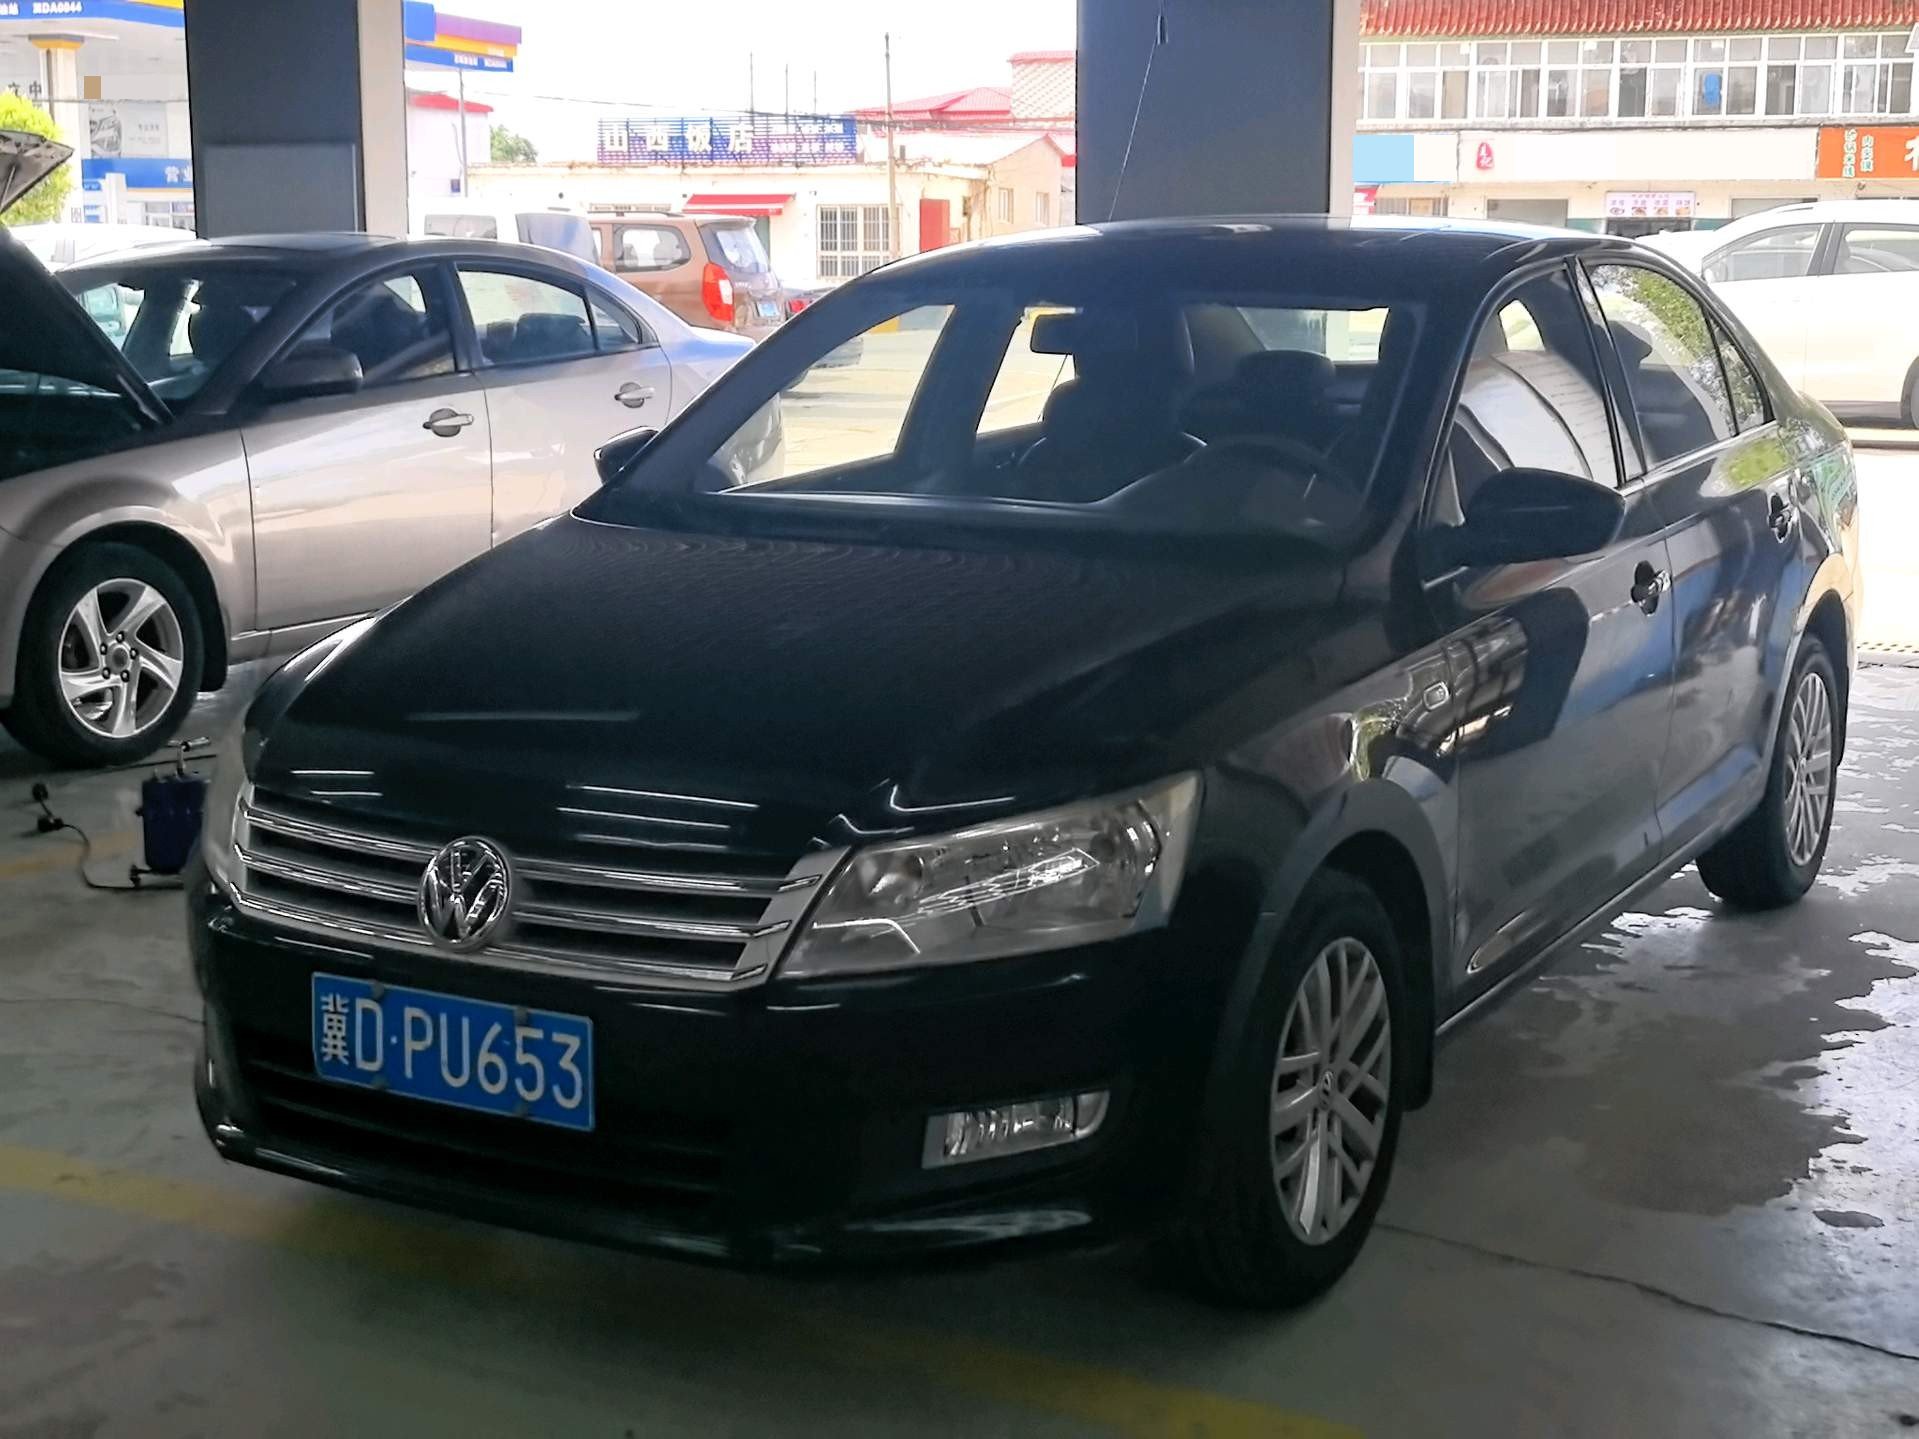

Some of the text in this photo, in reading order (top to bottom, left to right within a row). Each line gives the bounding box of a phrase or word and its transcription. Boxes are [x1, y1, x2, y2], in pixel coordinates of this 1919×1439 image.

[605, 123, 753, 153] 山西饭店
[320, 993, 583, 1109] 冀D·PU653
